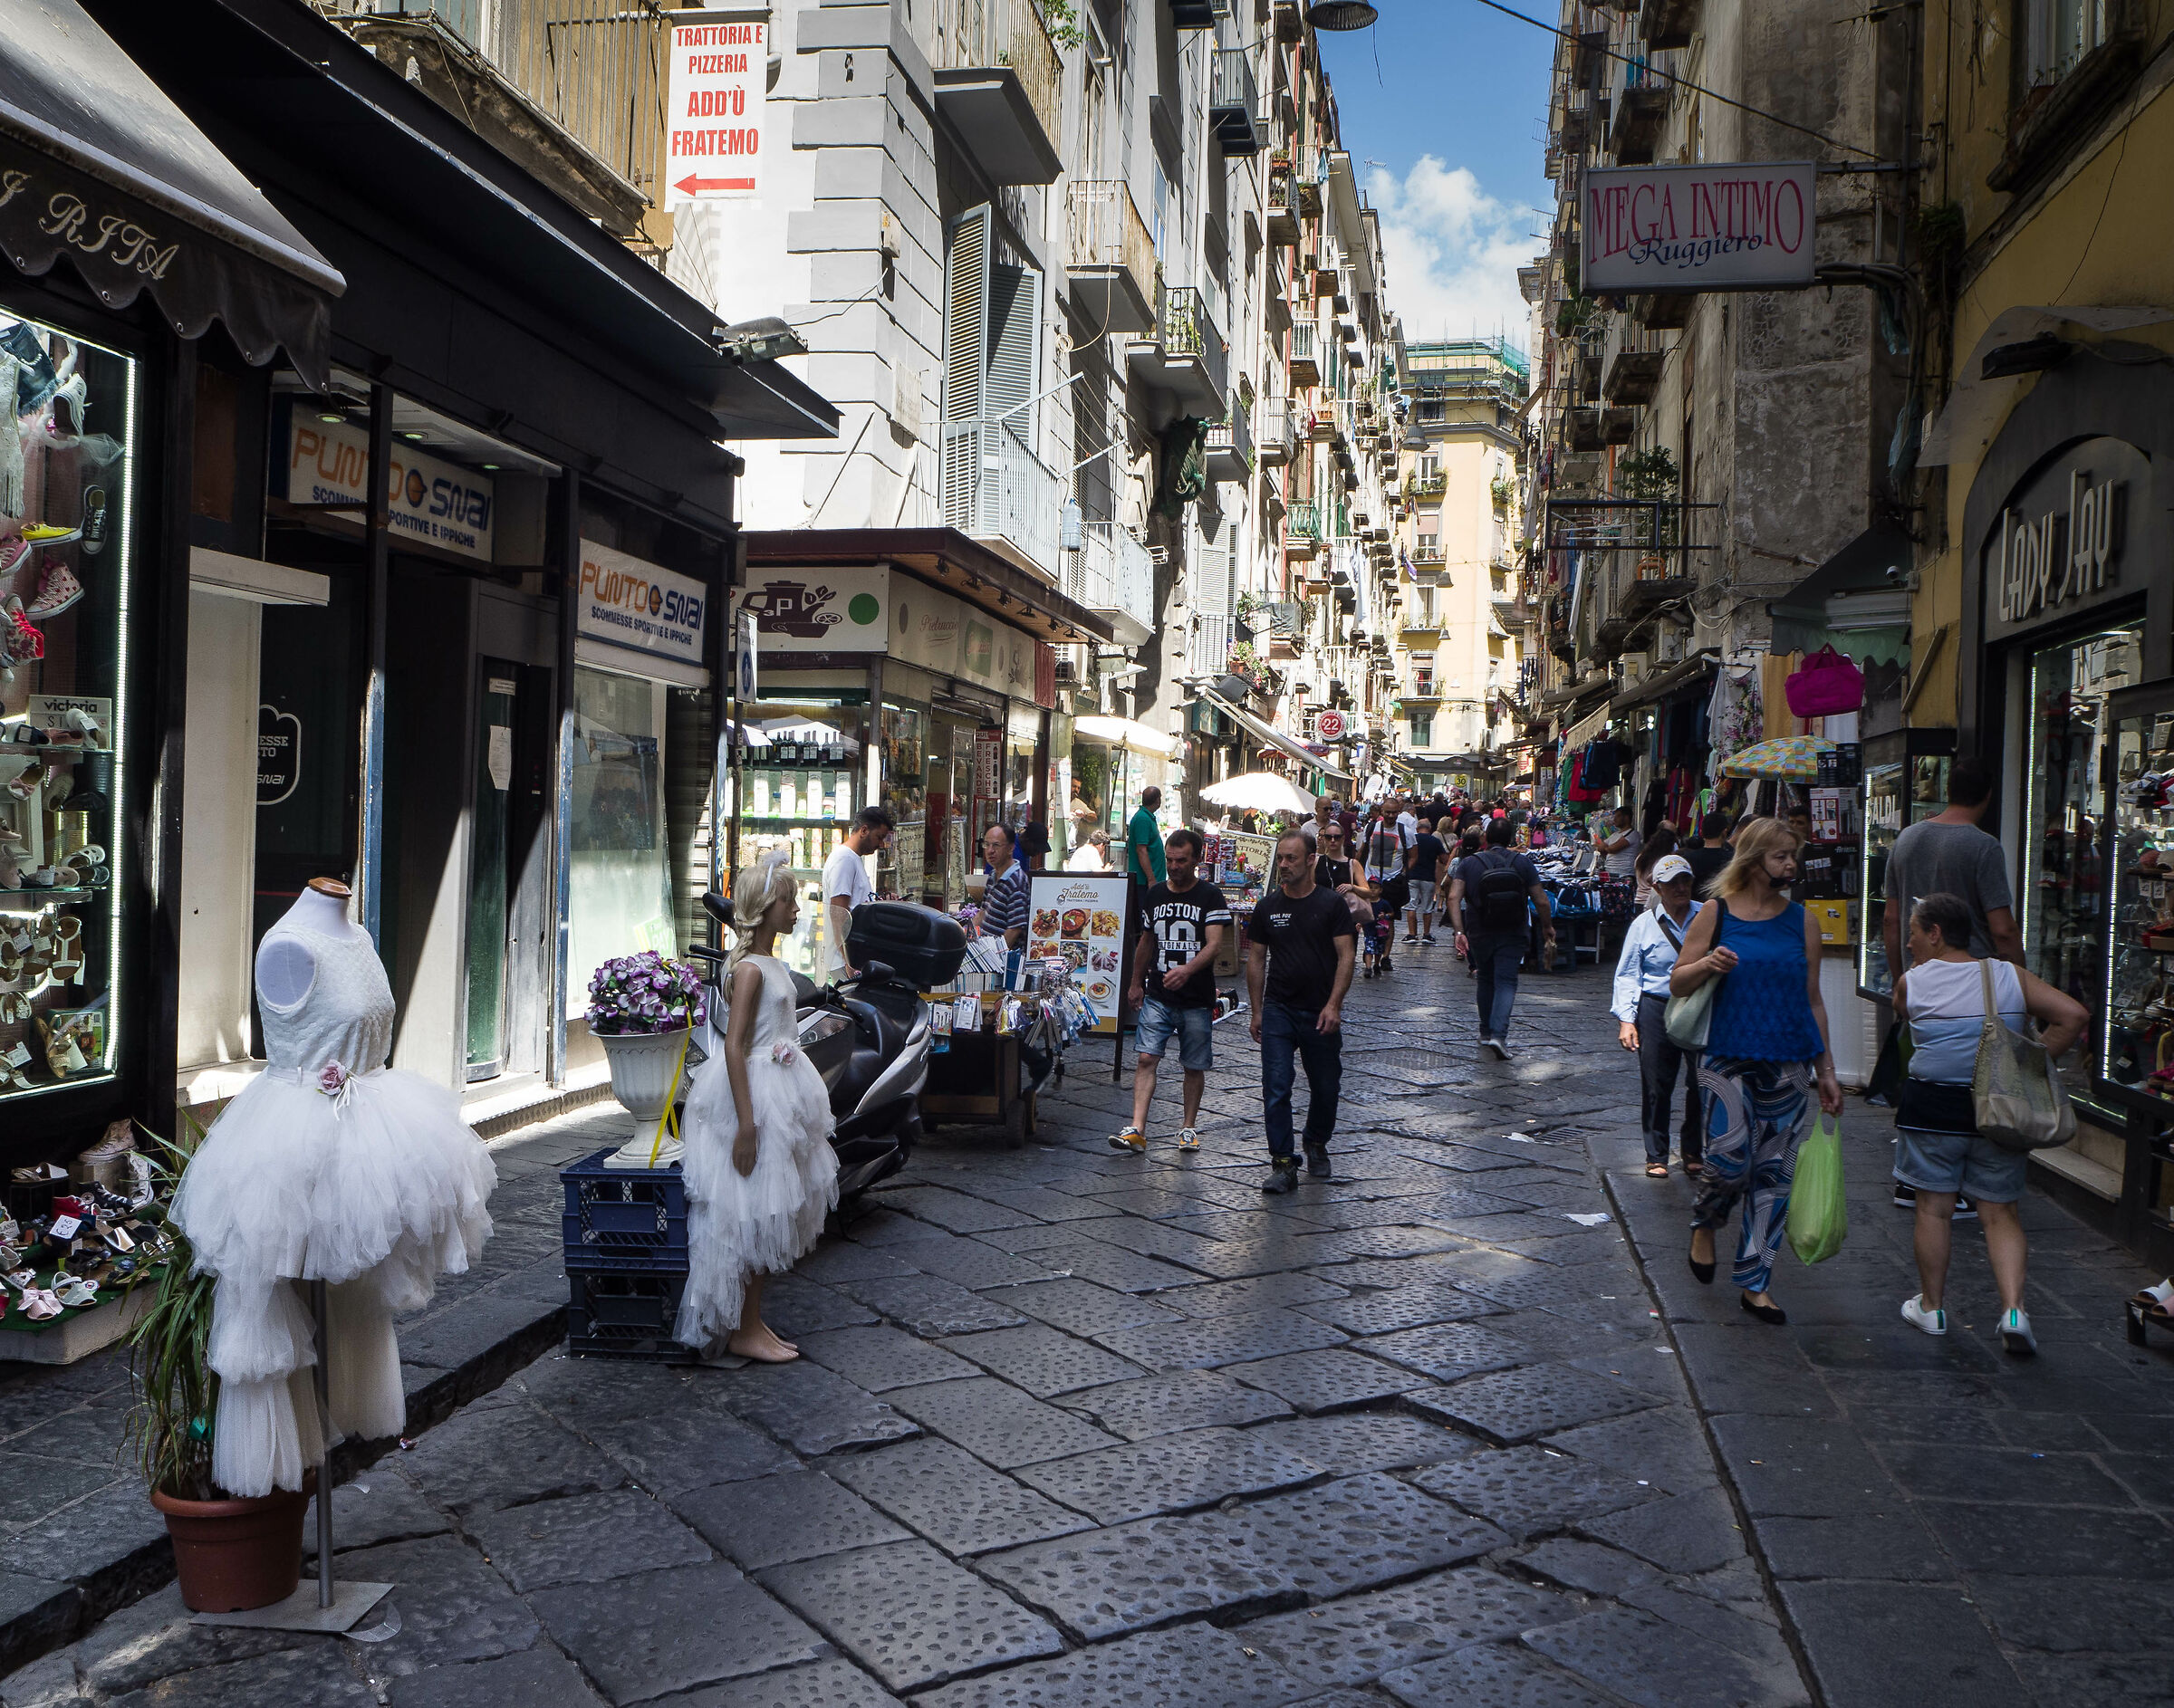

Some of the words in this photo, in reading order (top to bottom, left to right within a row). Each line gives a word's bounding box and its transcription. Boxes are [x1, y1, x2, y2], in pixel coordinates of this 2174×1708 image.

[676, 25, 752, 47] TRATTORIA
[755, 25, 763, 43] E
[688, 53, 748, 74] PIZZERIA
[671, 128, 759, 157] FRATEMO
[38, 192, 180, 280] RITA
[1590, 182, 1679, 264] MEGA
[1689, 178, 1804, 254] INTIMO
[1628, 231, 1763, 269] Ruggiero
[292, 427, 404, 501] PUNO
[388, 509, 429, 536] PORTIVE
[432, 524, 438, 537] E
[439, 525, 476, 549] IPPICHE
[1998, 506, 2054, 622] LADY
[2057, 467, 2115, 604] JAY
[579, 560, 649, 613] PUNTO
[591, 605, 633, 629] SCOMMESSE
[633, 618, 664, 638] SPORTIVE
[664, 627, 669, 639] E
[669, 629, 693, 646] IPPICHE
[44, 699, 98, 713] victoria
[1323, 717, 1339, 731] 22
[1152, 903, 1201, 922] BOSTON
